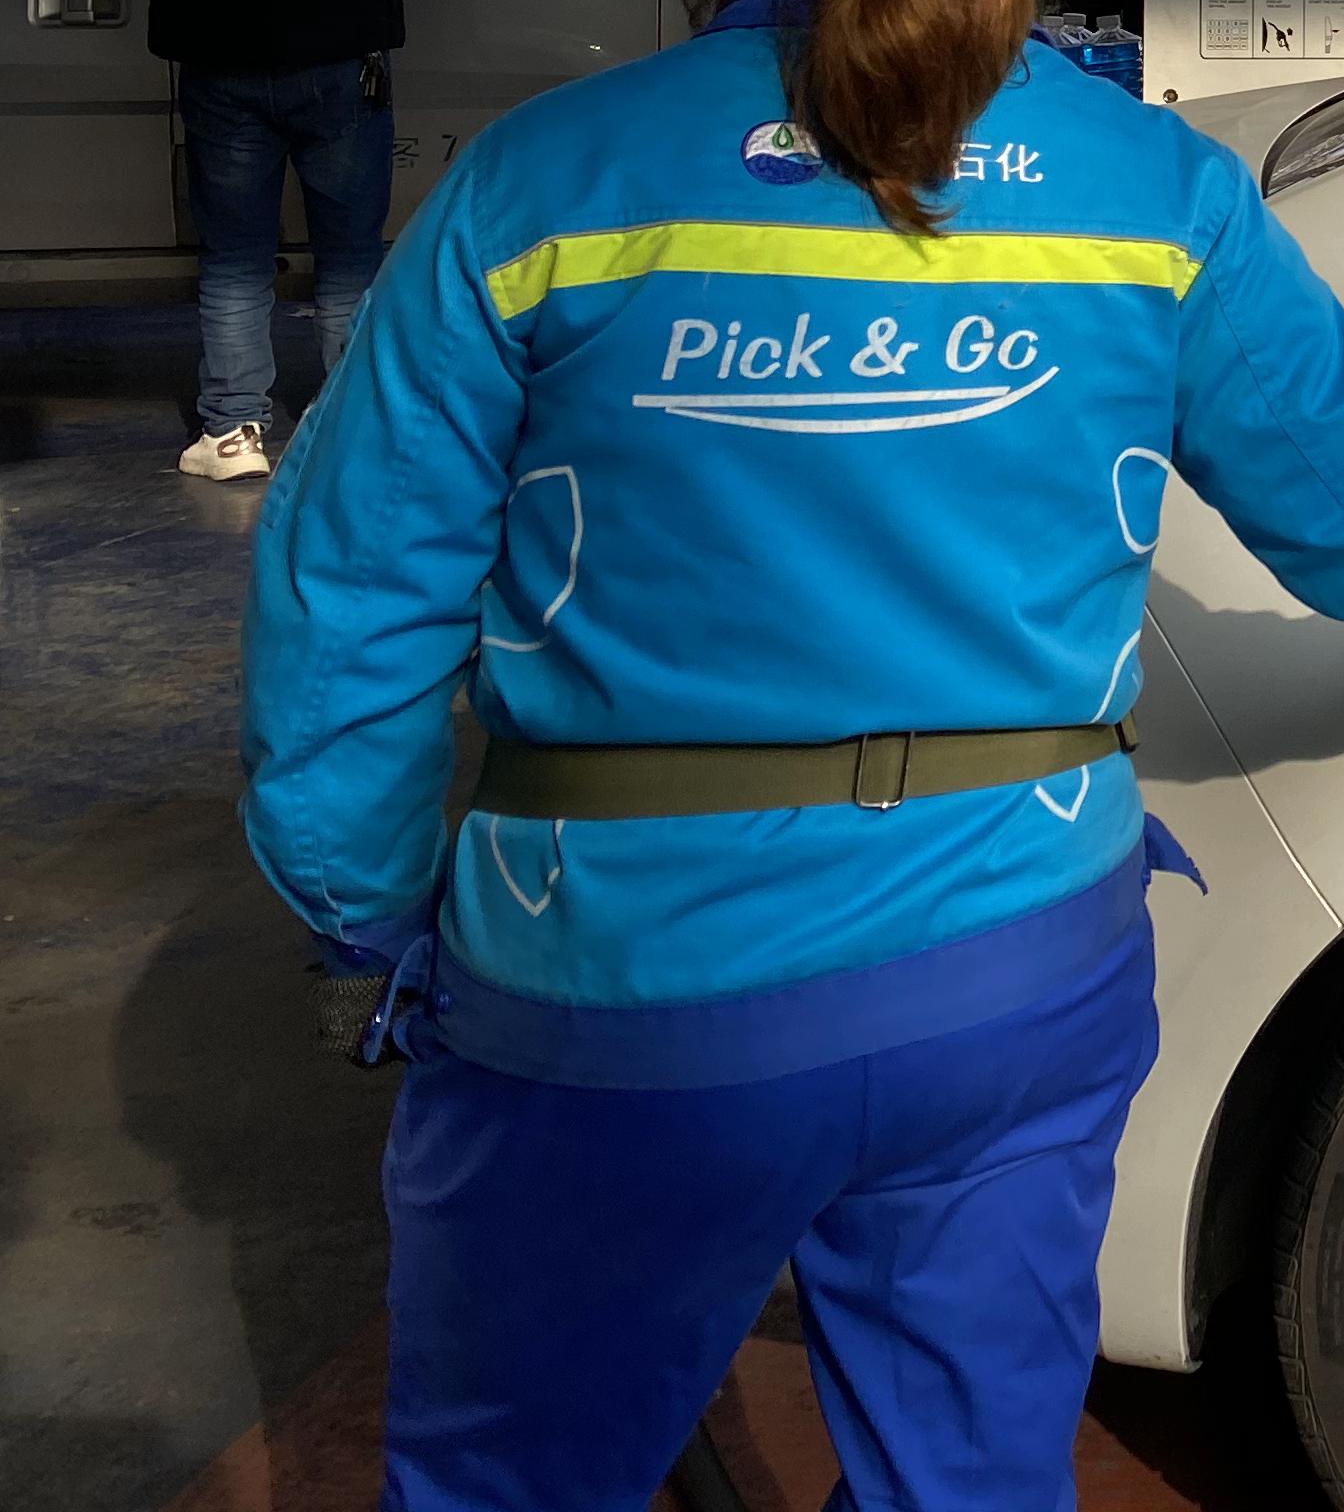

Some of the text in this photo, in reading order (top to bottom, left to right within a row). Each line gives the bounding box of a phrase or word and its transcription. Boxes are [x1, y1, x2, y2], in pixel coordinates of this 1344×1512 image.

[661, 313, 1038, 382] Pick & Go
